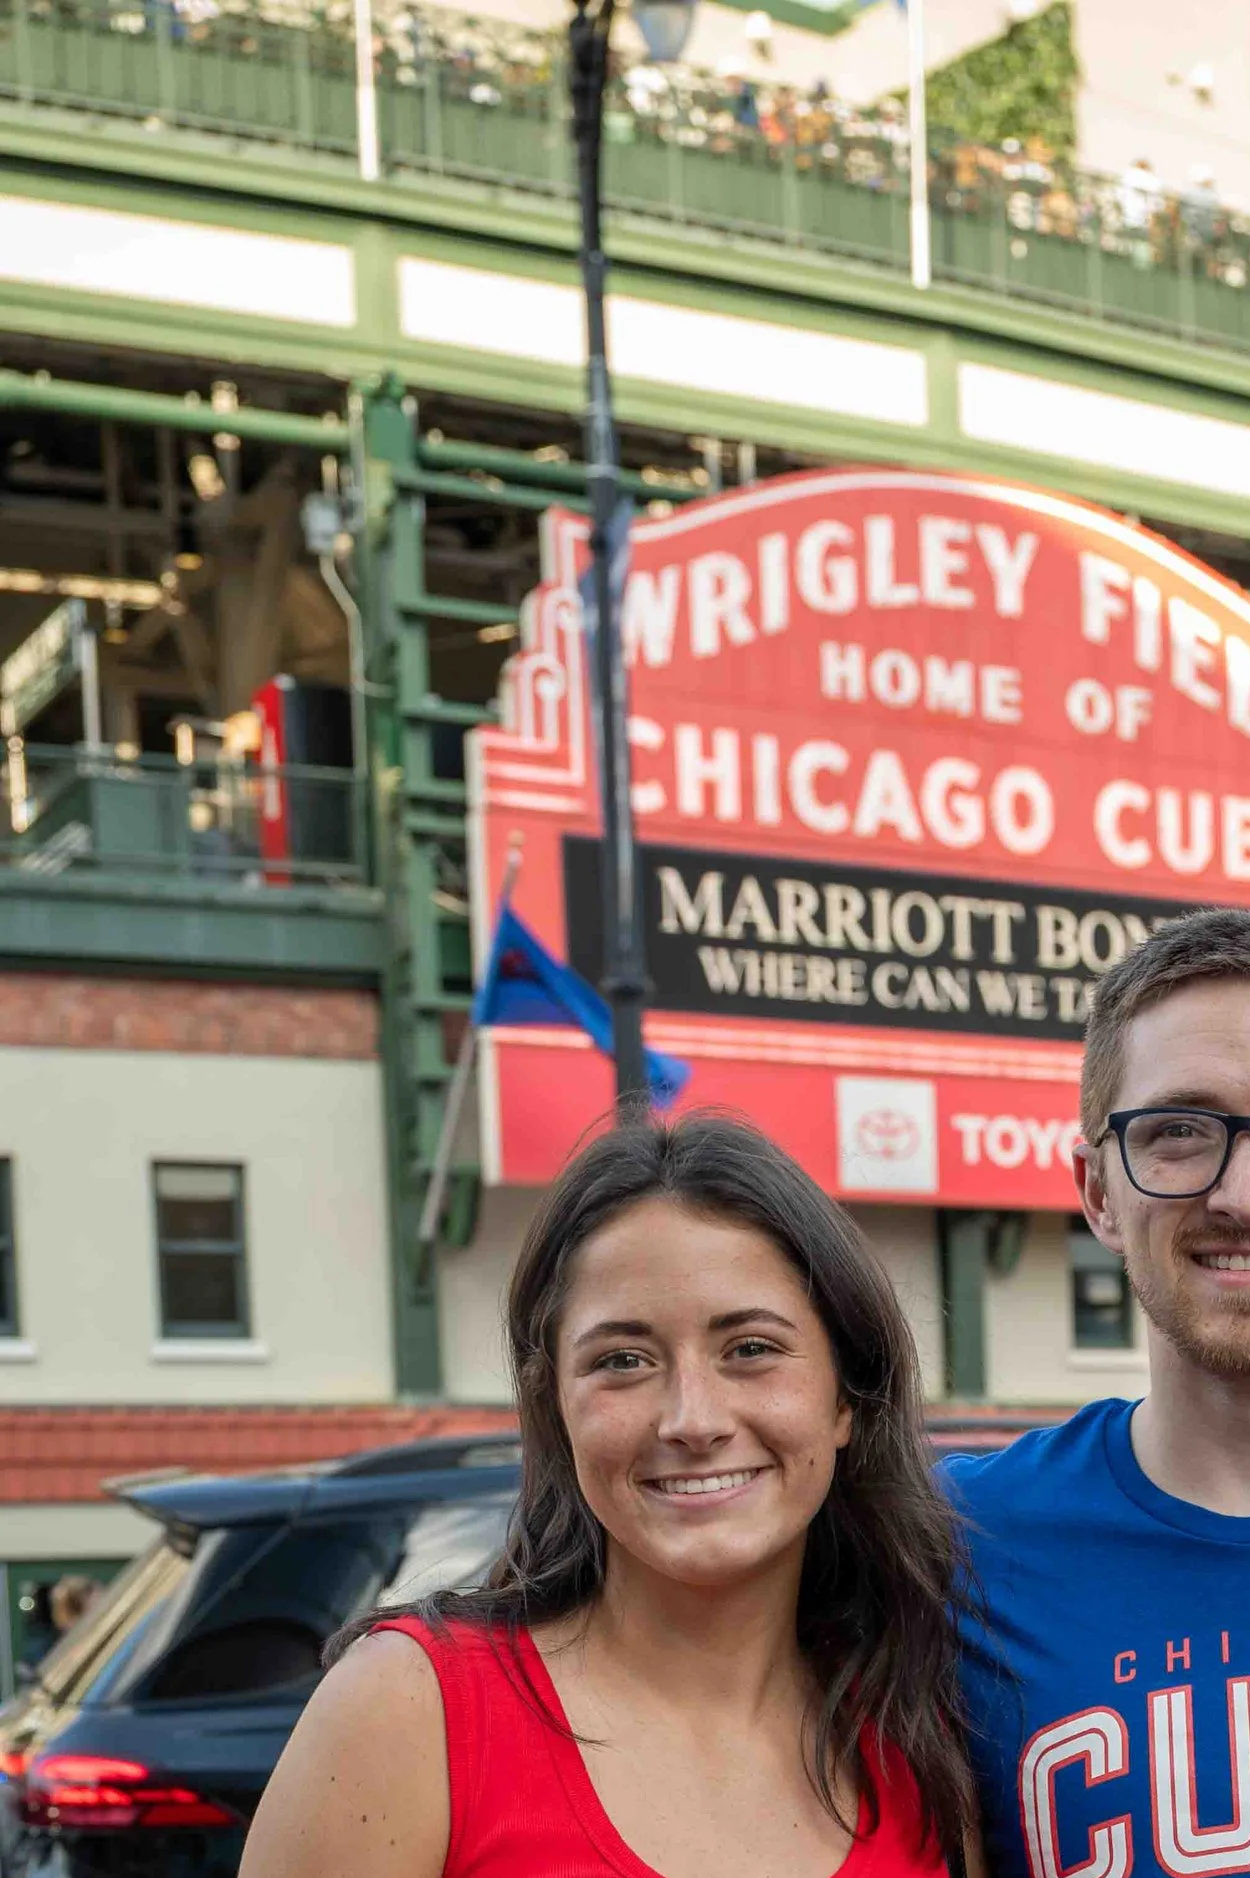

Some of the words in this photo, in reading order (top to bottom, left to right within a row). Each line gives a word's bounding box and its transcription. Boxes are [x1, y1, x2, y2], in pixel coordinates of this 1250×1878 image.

[622, 513, 1039, 669] WRIGLEY
[819, 640, 1024, 724] HOME
[1064, 676, 1153, 742] OF
[626, 715, 1055, 855] CHICAGO
[657, 866, 1025, 964] MARRIOTT
[699, 945, 868, 1005] WHERE
[872, 962, 970, 1014] CAN
[977, 970, 1048, 1022] WE
